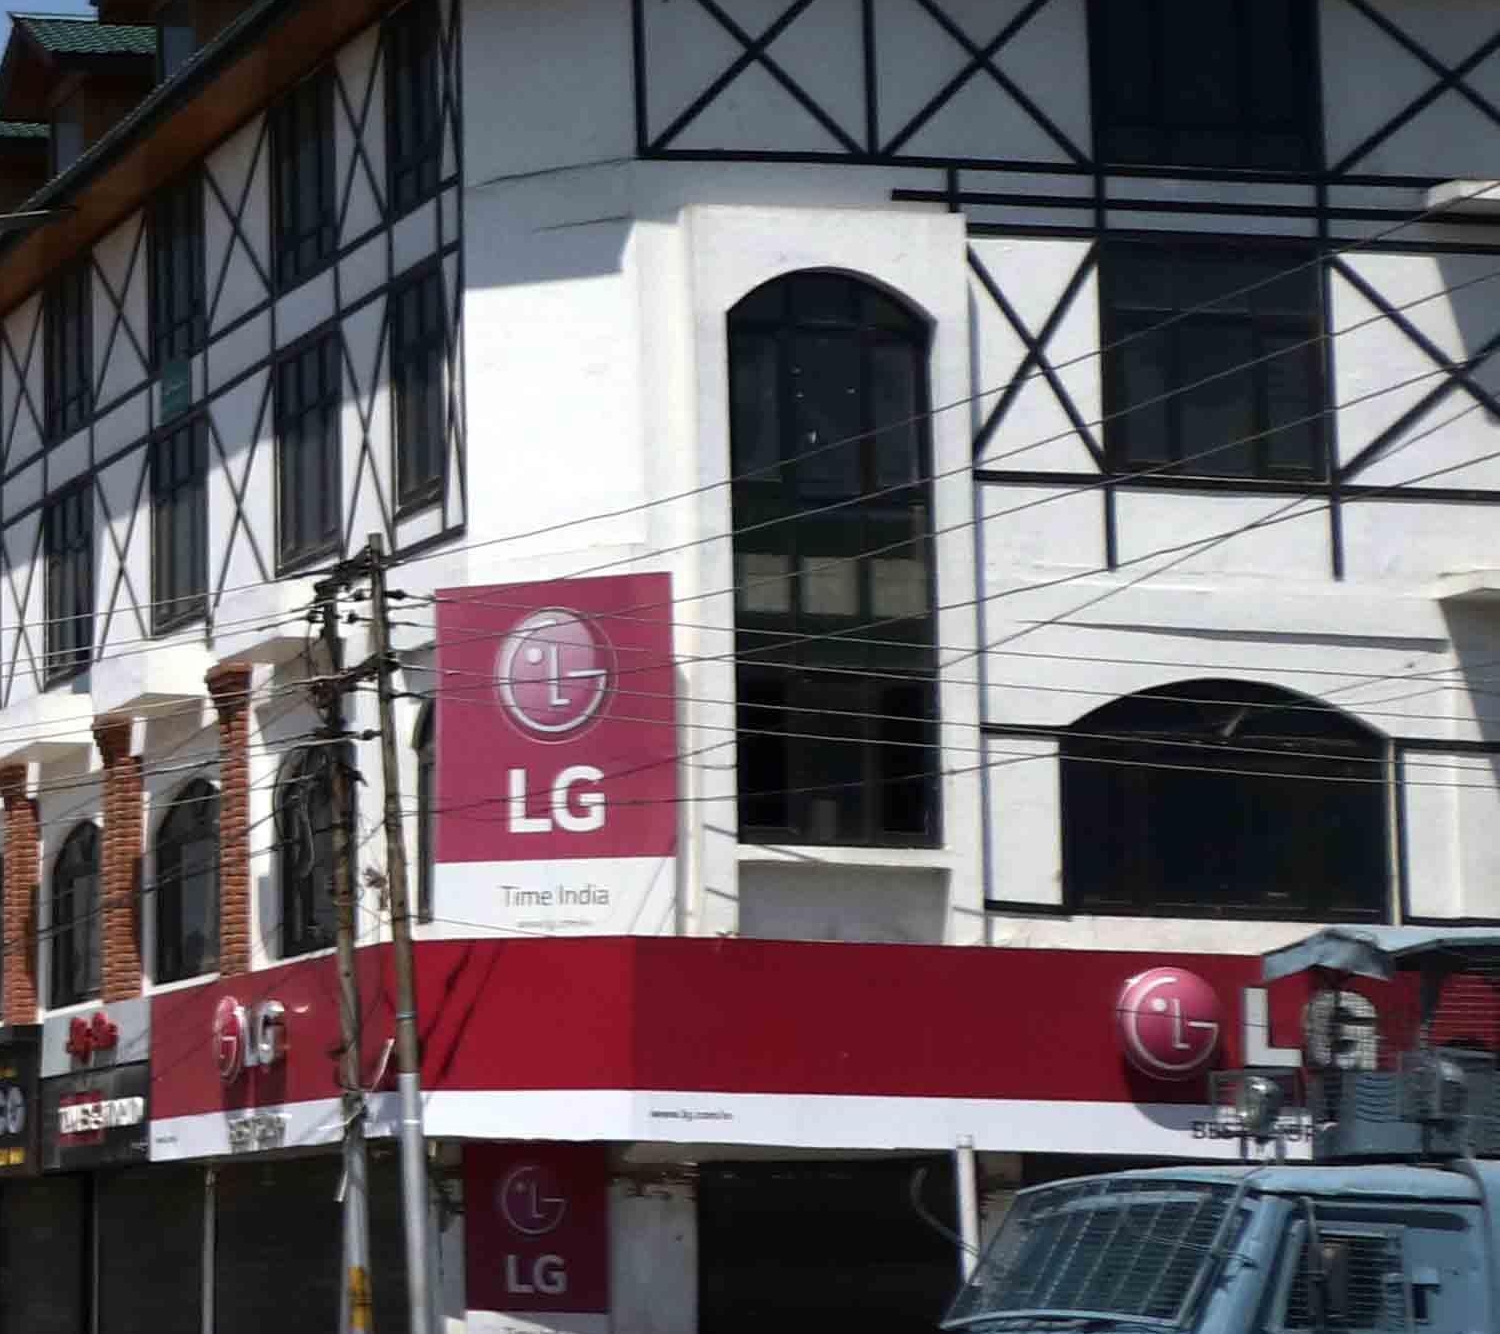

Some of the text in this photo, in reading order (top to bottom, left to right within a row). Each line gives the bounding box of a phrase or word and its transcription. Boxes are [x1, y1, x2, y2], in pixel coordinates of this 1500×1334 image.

[508, 765, 605, 833] LG
[499, 883, 609, 908] Time India
[505, 1254, 567, 1295] LG
